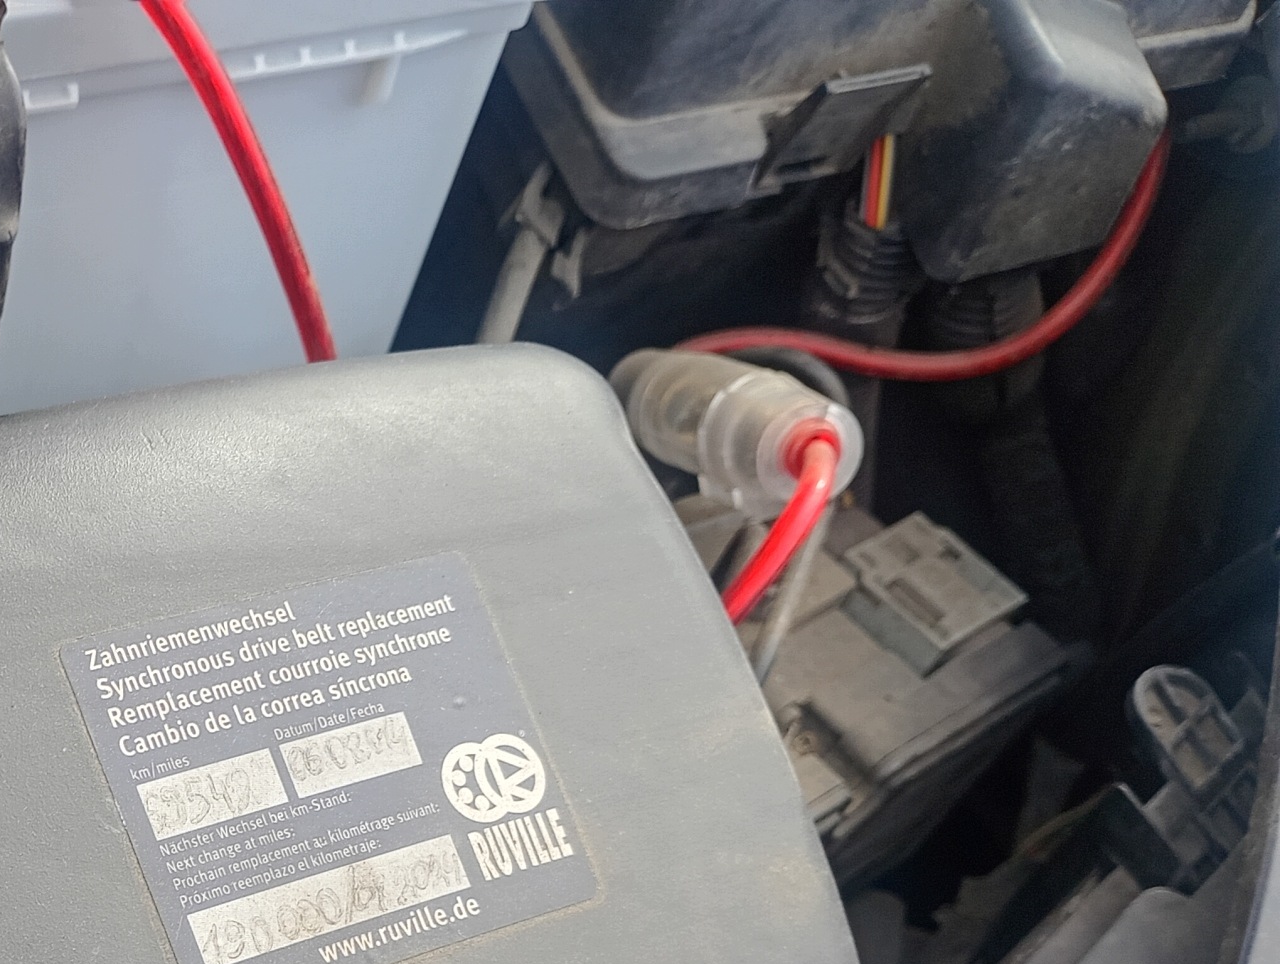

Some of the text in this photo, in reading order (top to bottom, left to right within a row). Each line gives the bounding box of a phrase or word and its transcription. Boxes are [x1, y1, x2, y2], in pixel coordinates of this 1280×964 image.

[85, 601, 296, 670] Zahnriemenwechsel
[97, 594, 455, 700] Synchronous drive belt replacement
[108, 626, 451, 728] Remplacement courroie synchrone
[119, 664, 412, 756] Cambio de la correa síncrona
[274, 701, 385, 741] Datum/Date/Fecha
[130, 754, 190, 781] km/miles
[159, 792, 352, 857] Nächster Wechsel bei km-Stand:
[166, 826, 296, 875] Next change at miles:
[173, 866, 227, 892] Prochain
[228, 839, 312, 876] remplacement
[328, 815, 396, 844] kilométrage
[396, 802, 440, 824] suivant:
[468, 808, 574, 881] RUVILLE
[179, 838, 382, 909] Próximo reemplazo el kilometraje:
[318, 895, 481, 964] www.ruville.de
